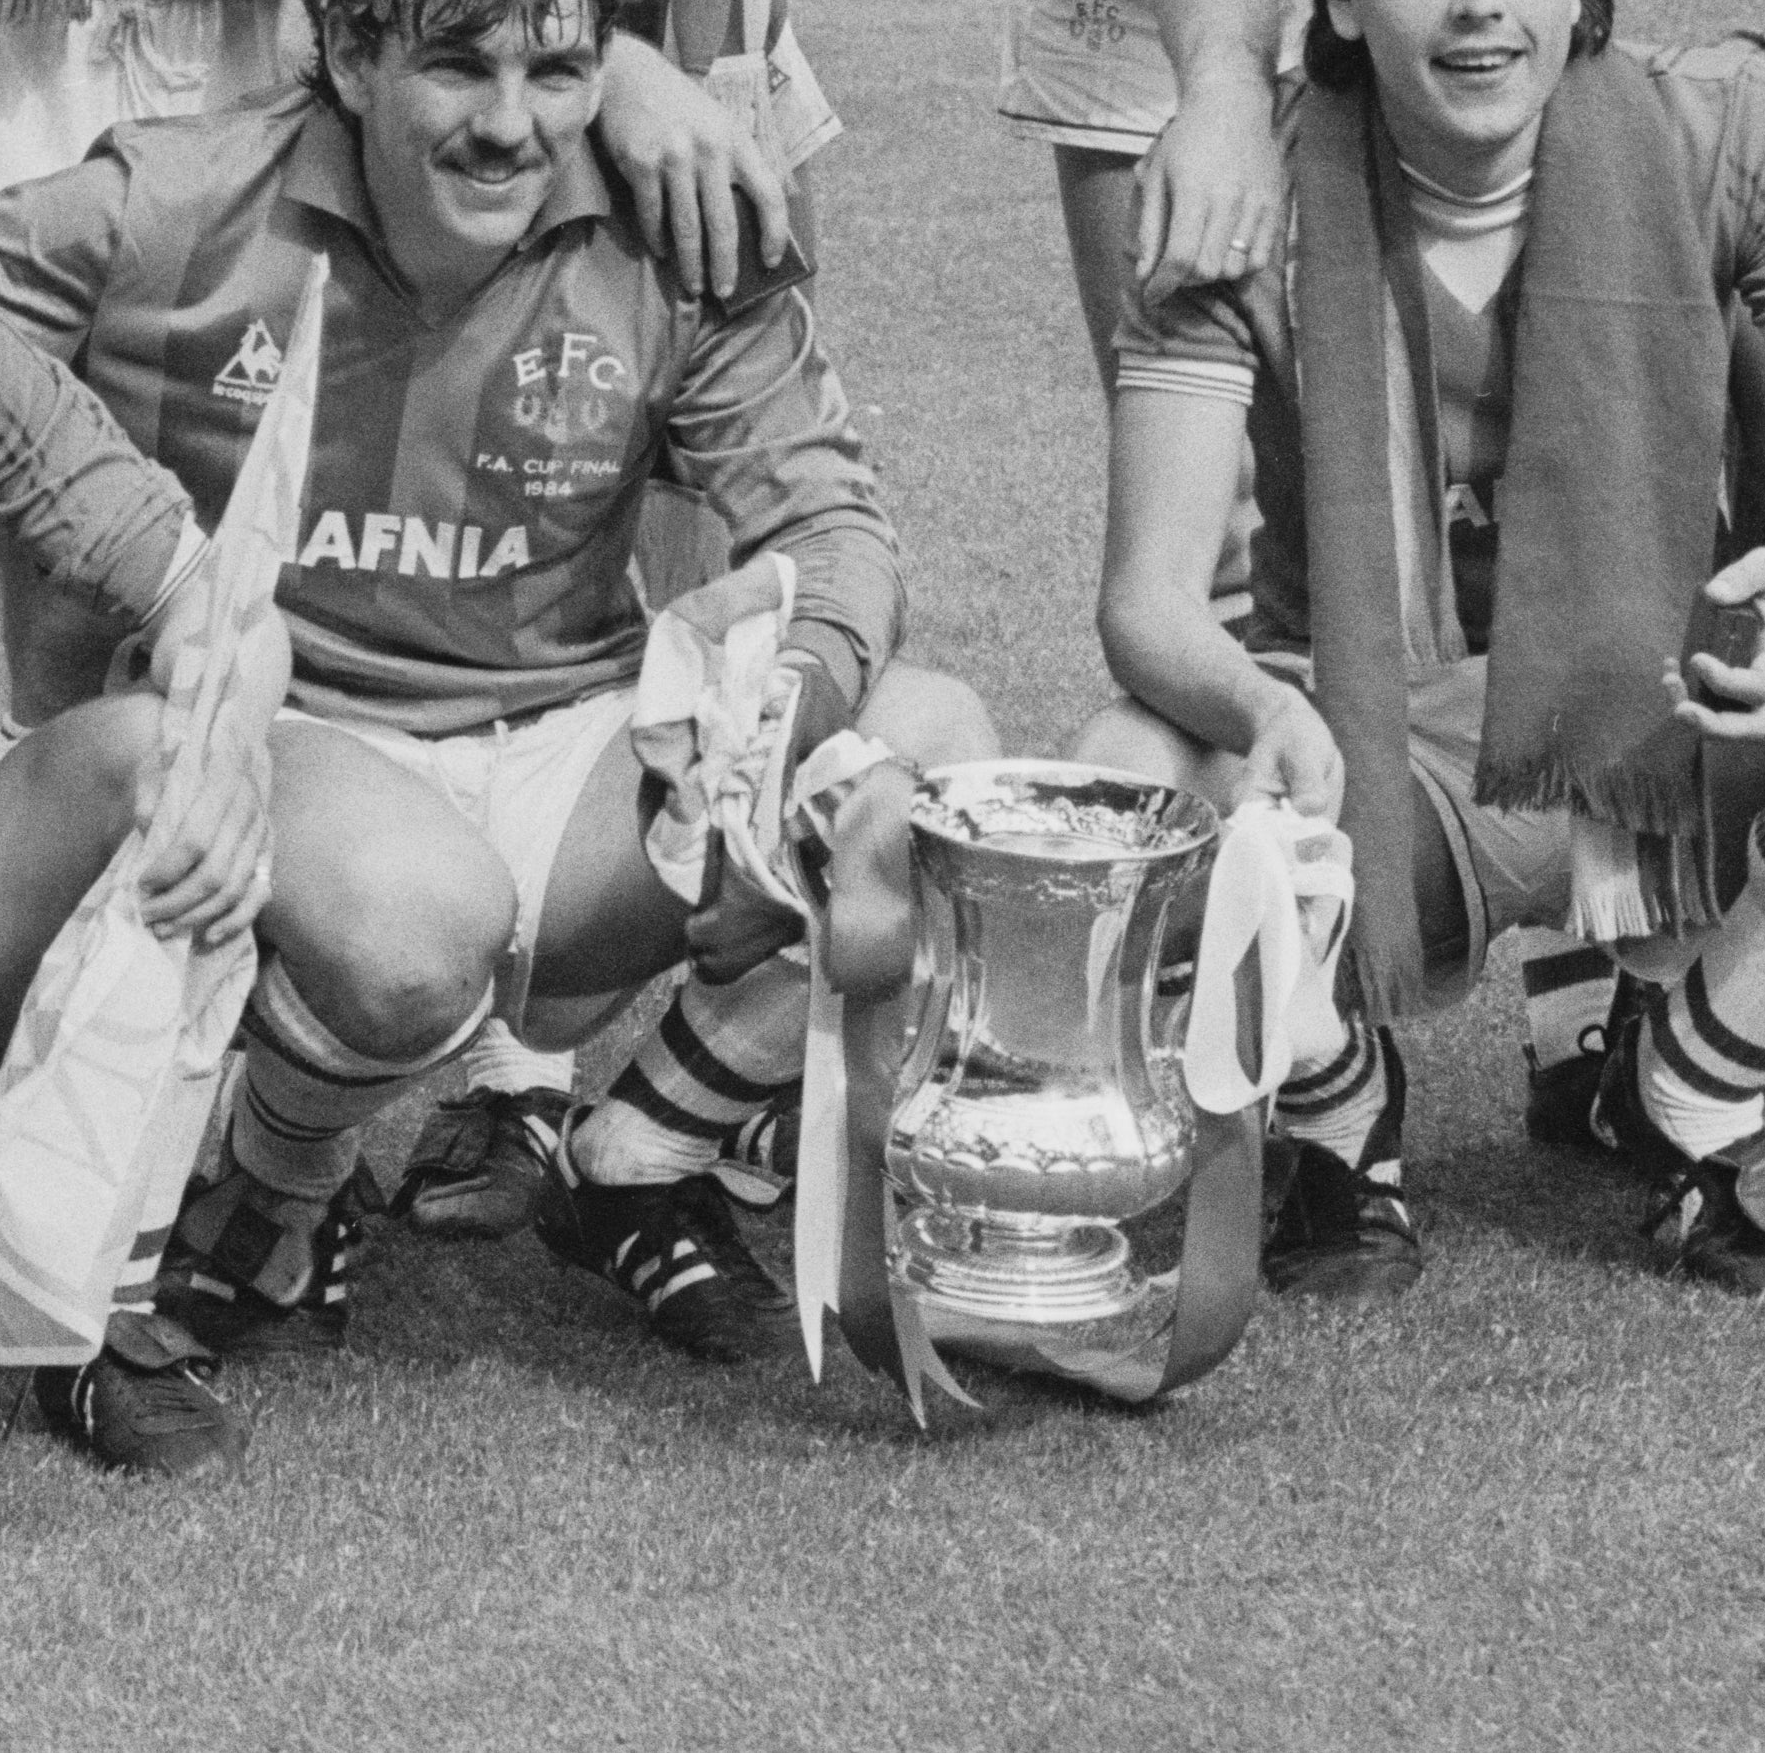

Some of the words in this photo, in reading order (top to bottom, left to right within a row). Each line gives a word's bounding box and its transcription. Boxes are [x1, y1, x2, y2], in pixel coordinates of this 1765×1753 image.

[513, 332, 627, 390] EFC
[476, 453, 514, 472] F.A.
[523, 458, 564, 475] CUP
[570, 460, 621, 477] FINAL
[524, 481, 573, 498] 1984
[282, 510, 531, 580] AFNIA
